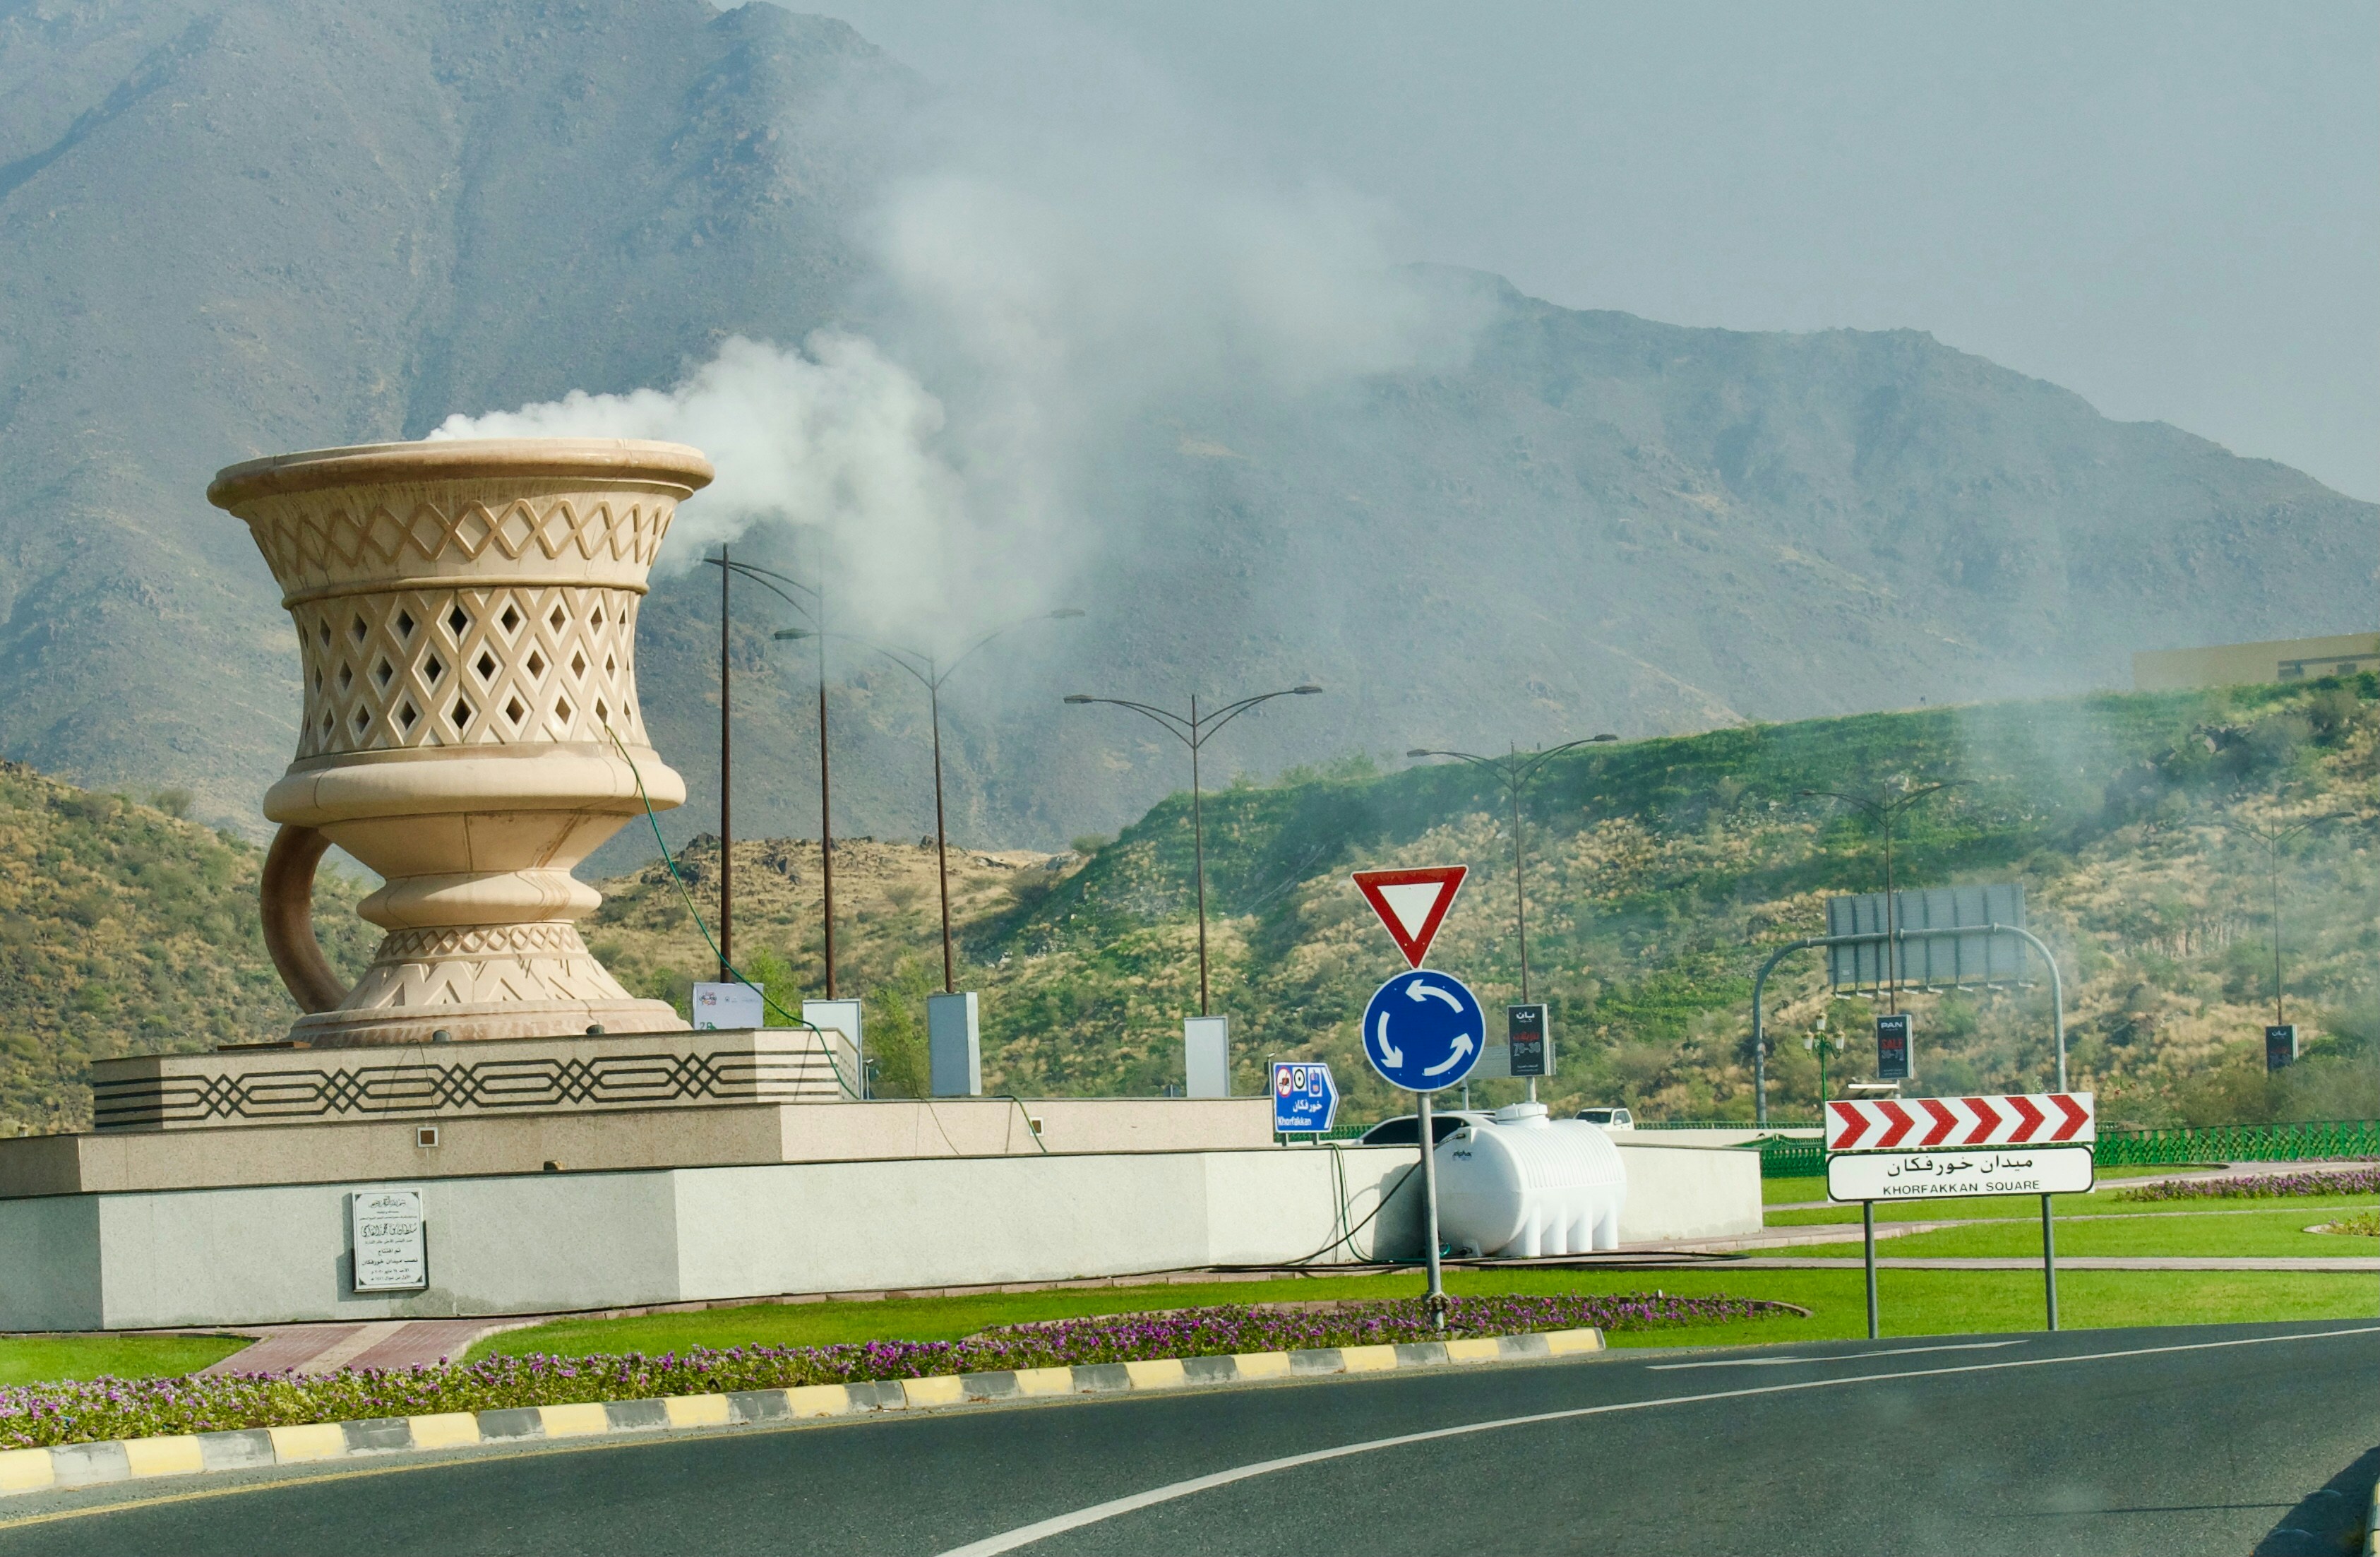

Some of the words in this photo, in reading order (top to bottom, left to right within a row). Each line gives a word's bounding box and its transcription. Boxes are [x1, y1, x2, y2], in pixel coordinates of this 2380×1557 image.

[1882, 1038, 1903, 1050] SALE
[1277, 1116, 1312, 1126] Khorfakkan
[1887, 1157, 1974, 1177] خورفكان
[1980, 1155, 2033, 1174] ميدان
[1883, 1183, 1978, 1195] KHORFAKKAN
[1986, 1180, 2040, 1192] SQUARE
